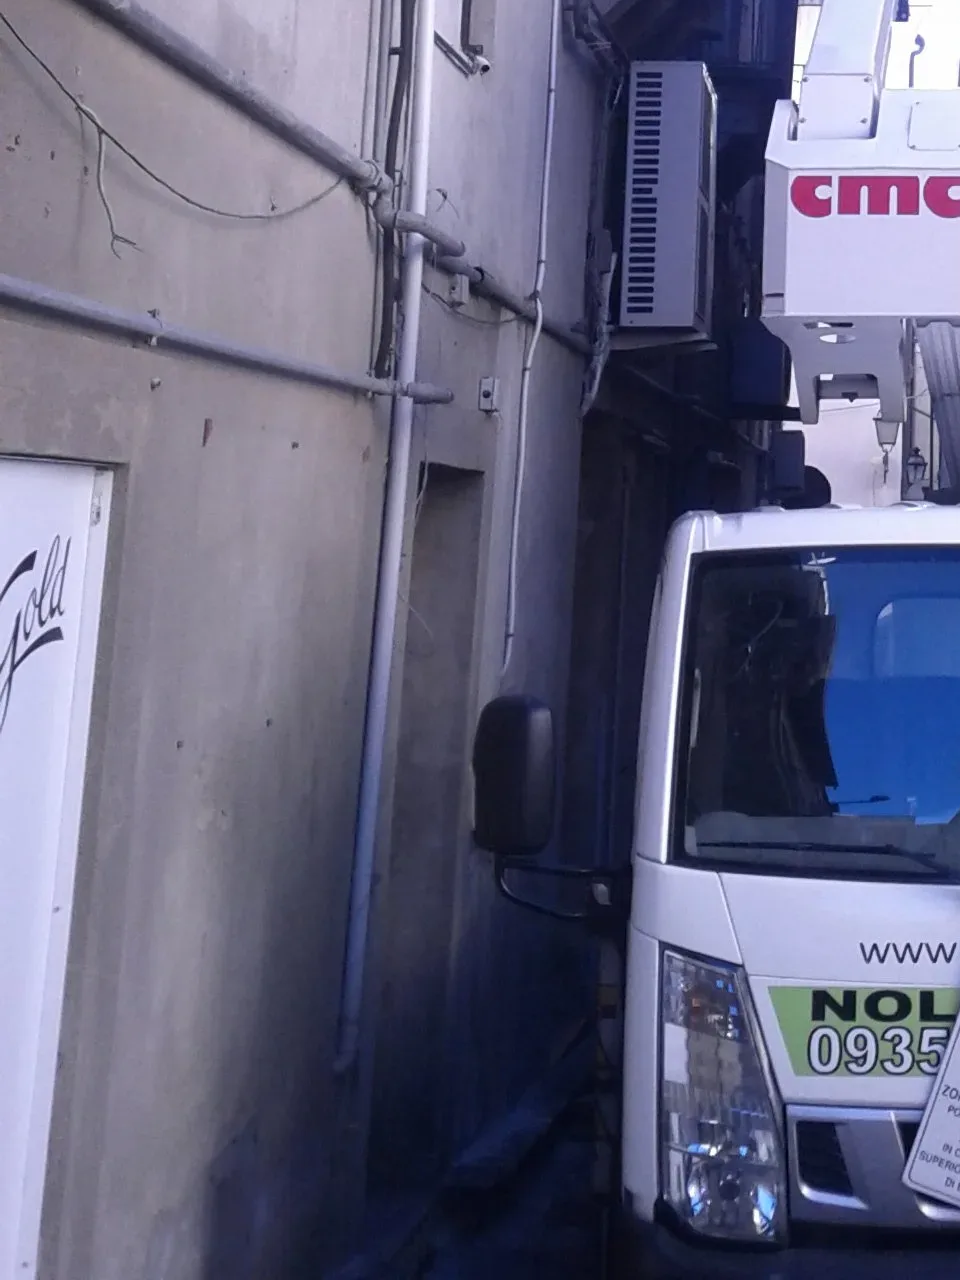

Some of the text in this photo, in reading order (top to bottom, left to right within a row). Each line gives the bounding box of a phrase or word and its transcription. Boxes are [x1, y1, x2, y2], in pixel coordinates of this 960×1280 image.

[808, 1025, 951, 1075] 0935
[942, 1143, 953, 1154] IN
[944, 1177, 955, 1188] DI
